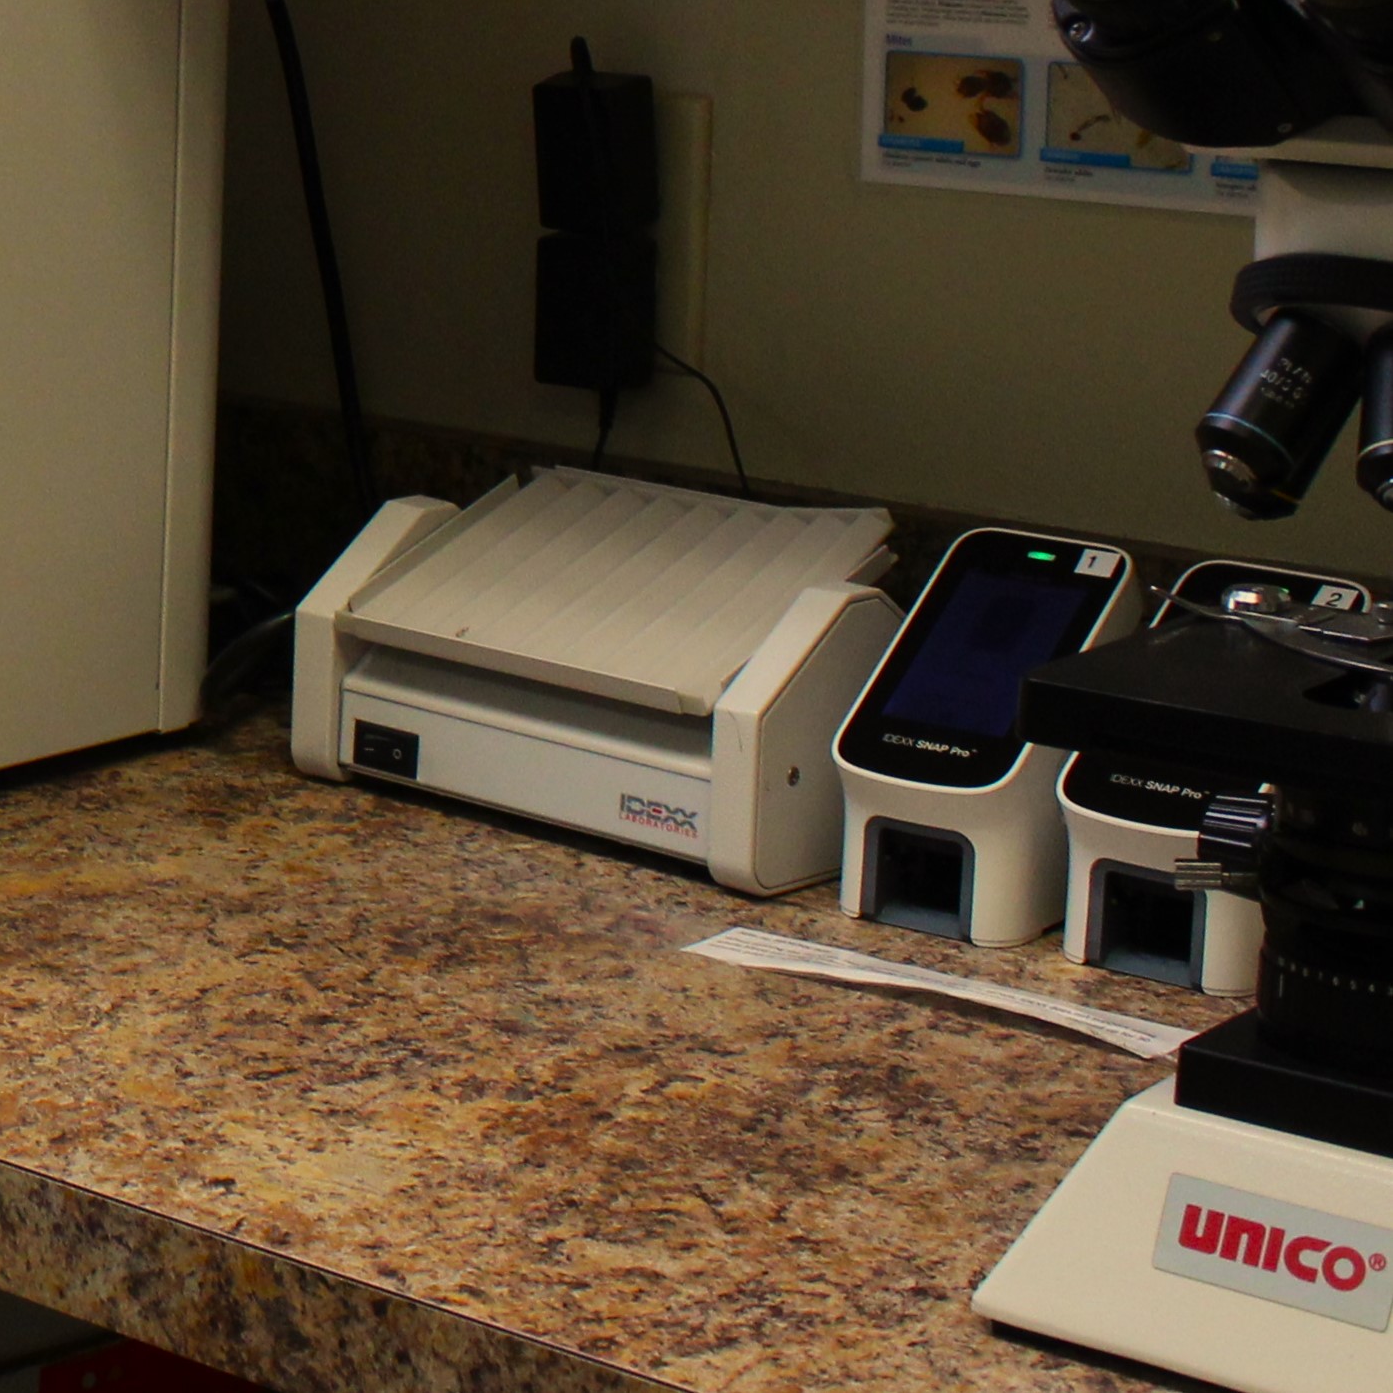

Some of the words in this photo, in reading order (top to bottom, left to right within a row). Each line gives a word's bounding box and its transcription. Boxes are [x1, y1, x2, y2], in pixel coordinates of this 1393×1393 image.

[1088, 555, 1097, 568] 1
[1326, 592, 1343, 607] 2
[882, 733, 915, 747] IDEXX
[915, 739, 950, 753] SNAP
[949, 746, 971, 758] Pro
[1110, 773, 1144, 788] IDEXX
[1144, 780, 1181, 794] SNAP
[1181, 787, 1203, 800] Pro
[619, 811, 699, 840] LABORATORIES
[620, 793, 699, 832] IDEXX
